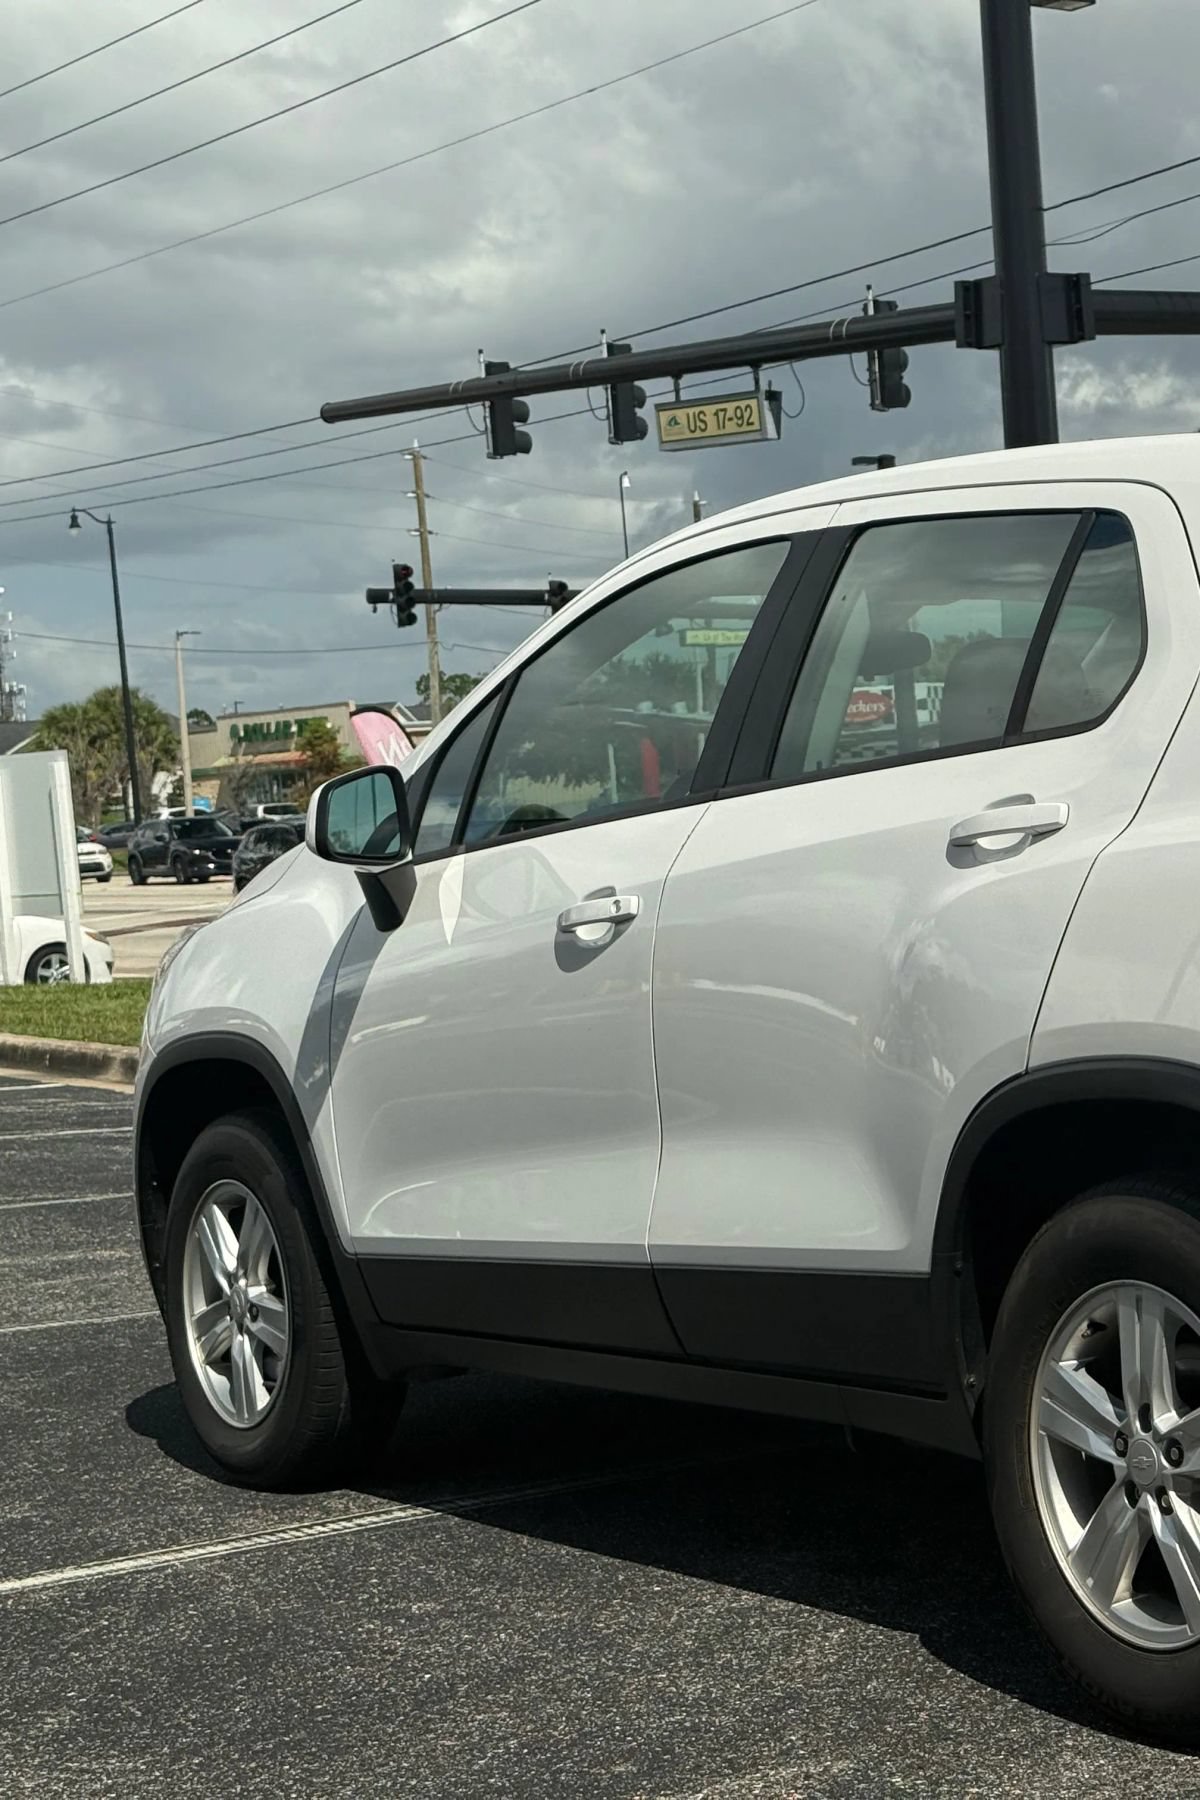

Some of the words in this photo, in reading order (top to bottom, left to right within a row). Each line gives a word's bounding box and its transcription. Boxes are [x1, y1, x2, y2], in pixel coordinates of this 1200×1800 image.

[686, 410, 708, 433] US
[713, 404, 755, 431] 17-92
[847, 699, 887, 713] eckers
